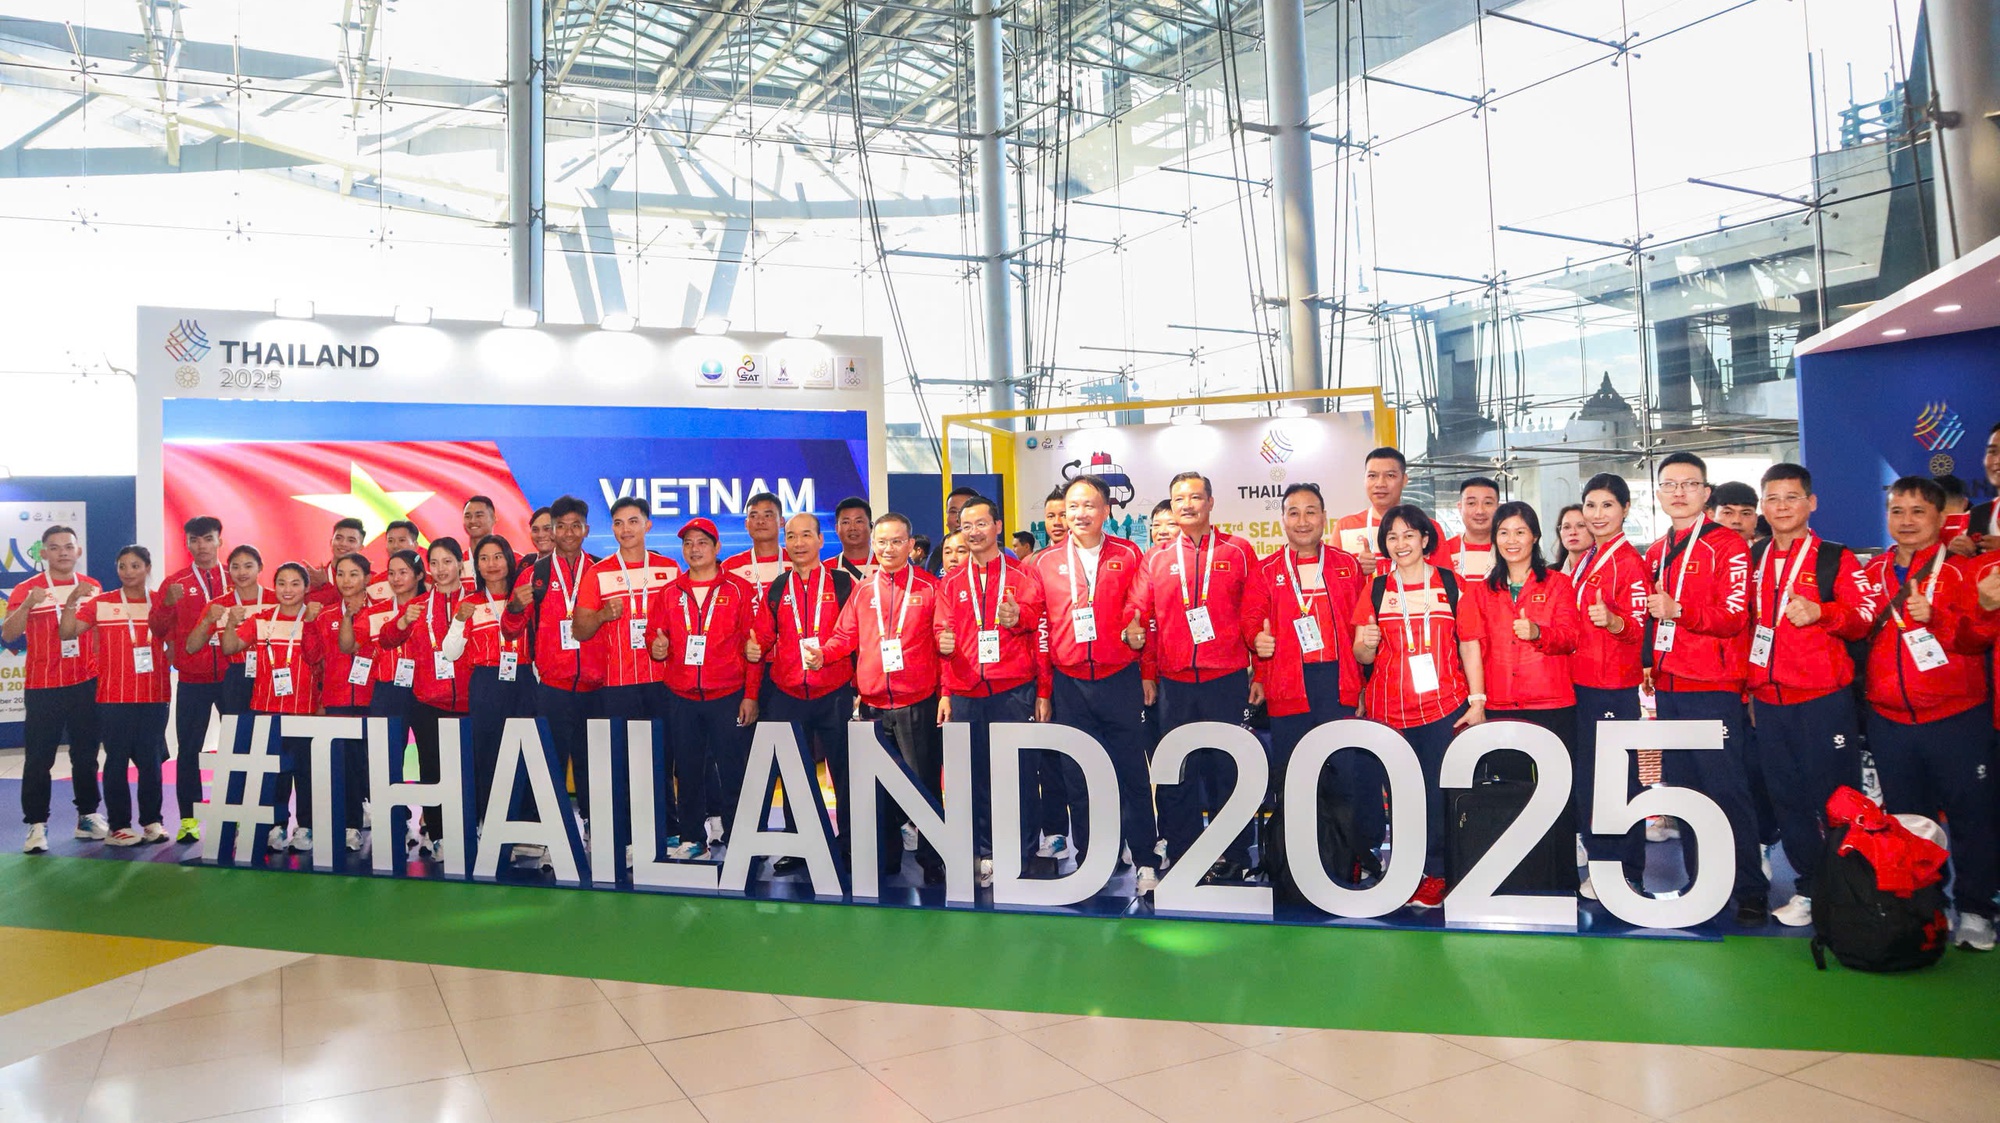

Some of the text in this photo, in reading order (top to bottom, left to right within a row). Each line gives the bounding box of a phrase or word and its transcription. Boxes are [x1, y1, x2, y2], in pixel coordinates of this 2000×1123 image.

[219, 340, 380, 368] THAILAND
[219, 368, 283, 389] 2025
[739, 374, 760, 382] SAT
[599, 478, 815, 515] VIETNAM
[1265, 500, 1282, 511] 20
[1249, 520, 1283, 538] SEA
[1728, 552, 1748, 615] VIETNA
